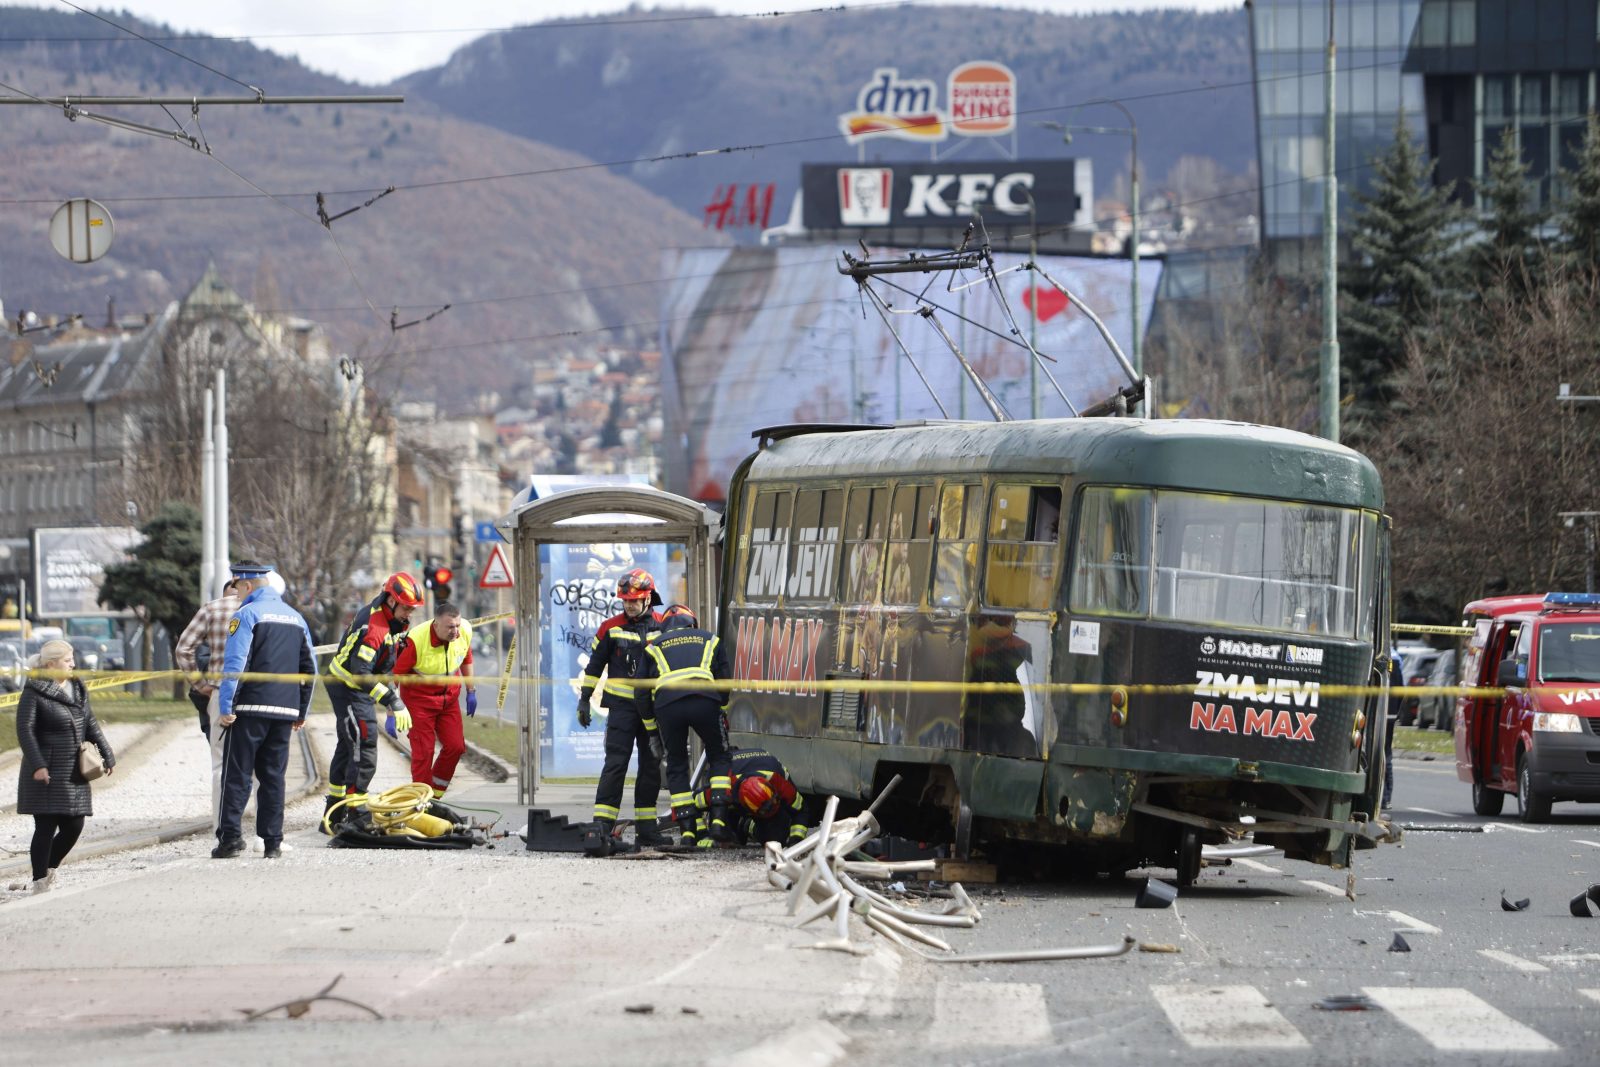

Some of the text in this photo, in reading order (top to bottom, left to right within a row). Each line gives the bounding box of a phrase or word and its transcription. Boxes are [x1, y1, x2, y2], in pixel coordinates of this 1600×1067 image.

[865, 74, 931, 113] dm
[952, 86, 1011, 98] BURGER
[952, 101, 1011, 117] KING
[904, 173, 1034, 217] KFC
[747, 527, 839, 598] ZMAJEVI
[732, 616, 824, 697] NA MAX
[1198, 657, 1322, 674] PREMIUM PARTNER REPREZENTACIJE
[1295, 646, 1324, 663] KSBIH
[1193, 670, 1321, 708] ZMAJEVI
[1190, 701, 1318, 742] NA MAX
